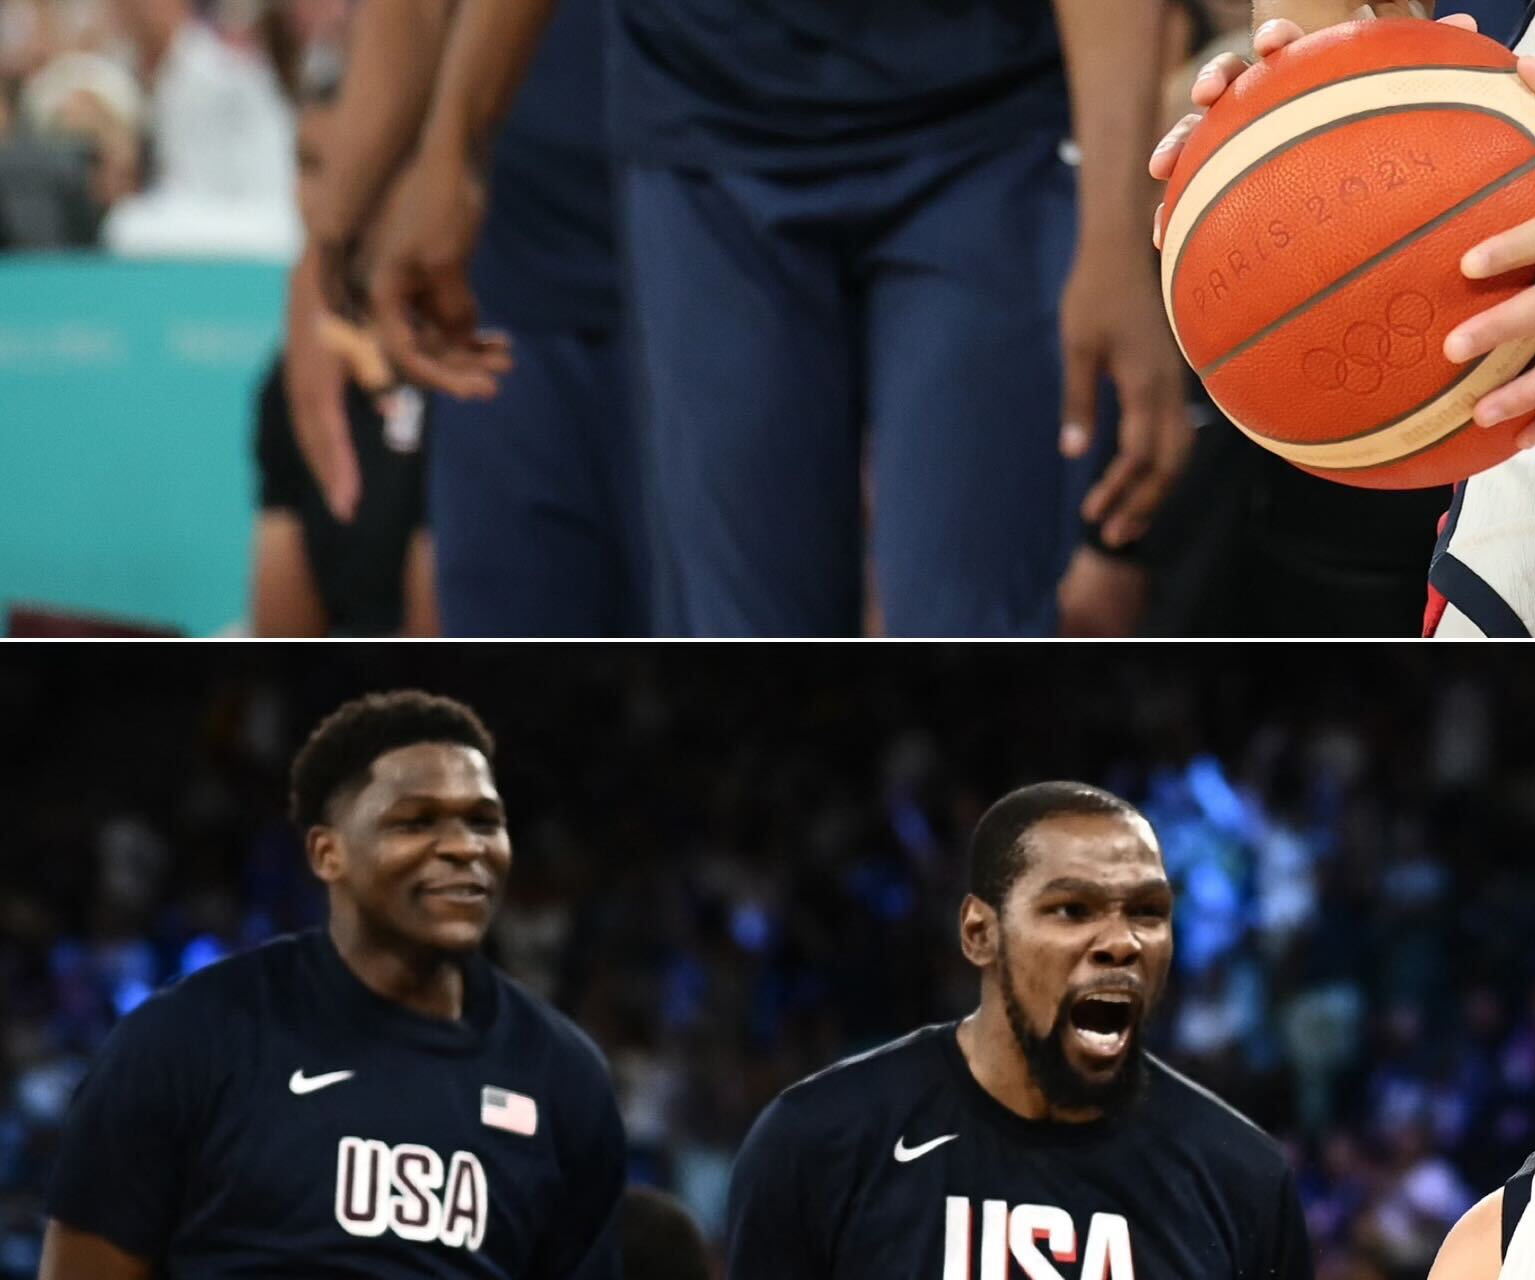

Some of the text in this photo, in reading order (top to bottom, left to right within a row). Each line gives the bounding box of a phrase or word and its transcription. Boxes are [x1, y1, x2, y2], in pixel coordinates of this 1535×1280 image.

[1192, 149, 1436, 312] PARIS 2024
[335, 1135, 488, 1252] USA
